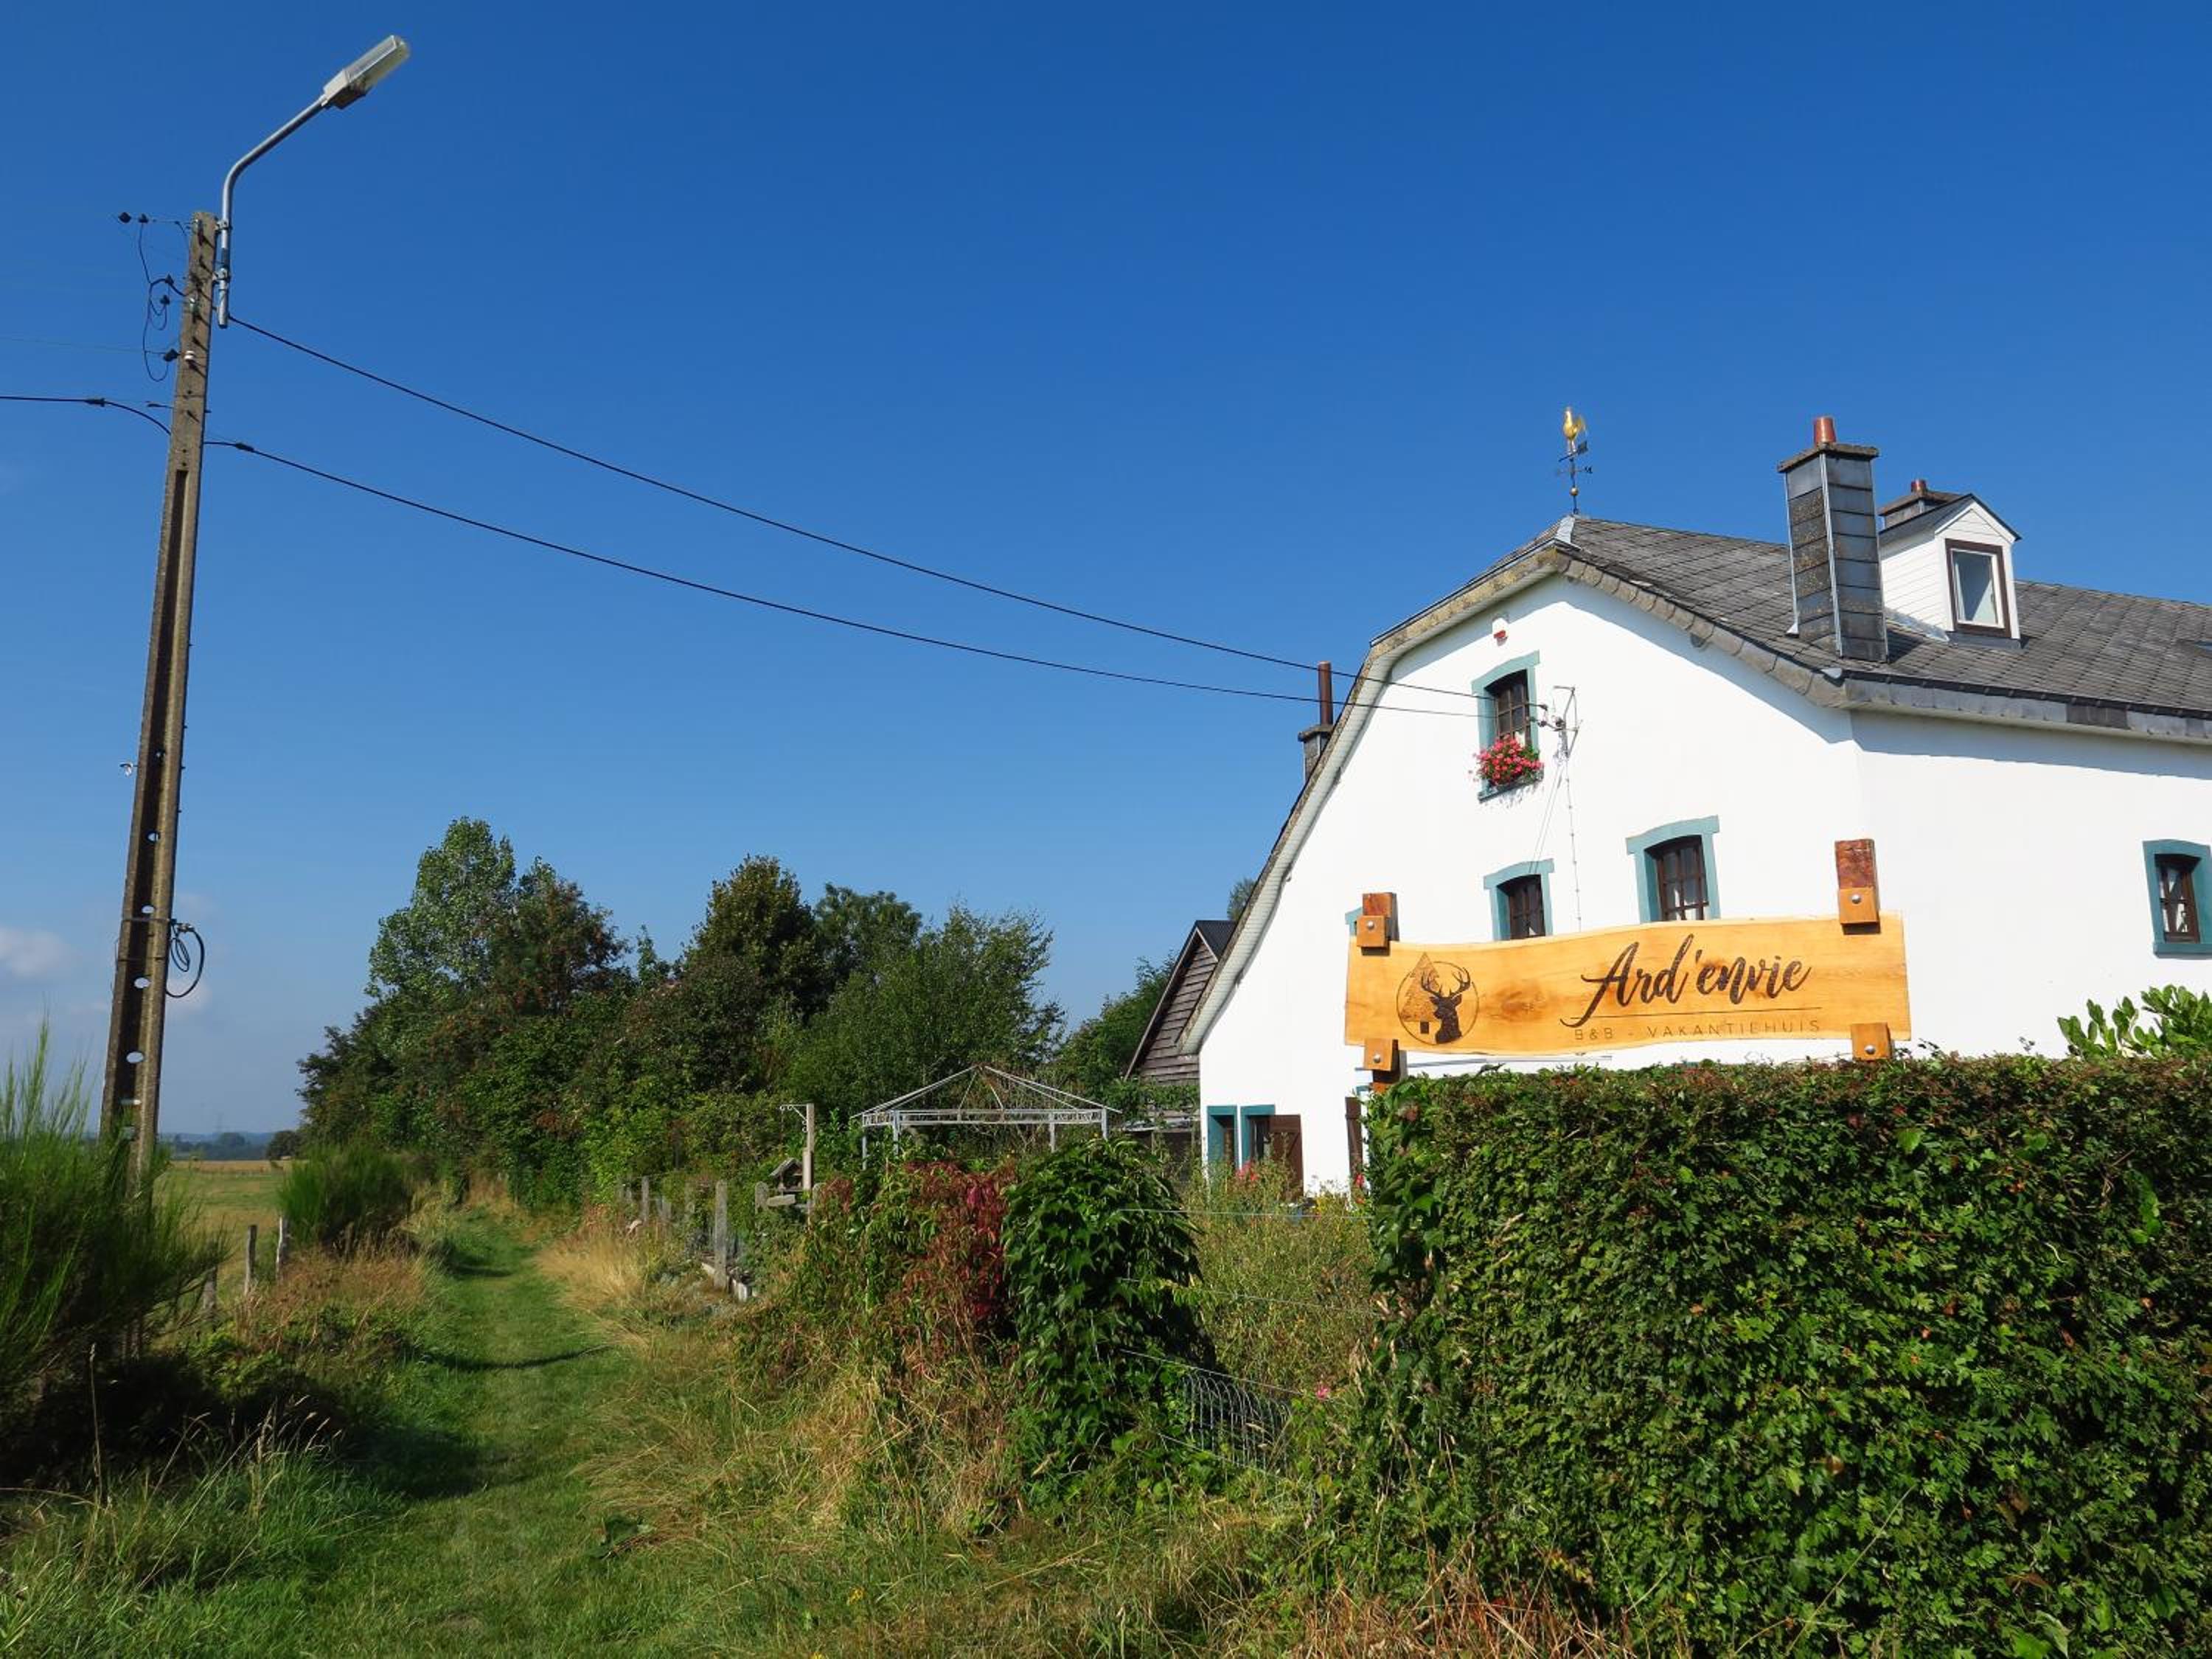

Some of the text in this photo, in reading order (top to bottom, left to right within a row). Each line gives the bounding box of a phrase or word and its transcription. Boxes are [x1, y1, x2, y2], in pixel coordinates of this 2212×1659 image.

[1560, 933, 1812, 1028] Ard'envie
[1574, 1028, 1613, 1040] B&B
[1646, 1020, 1820, 1037] VAKANTIEHUIS
